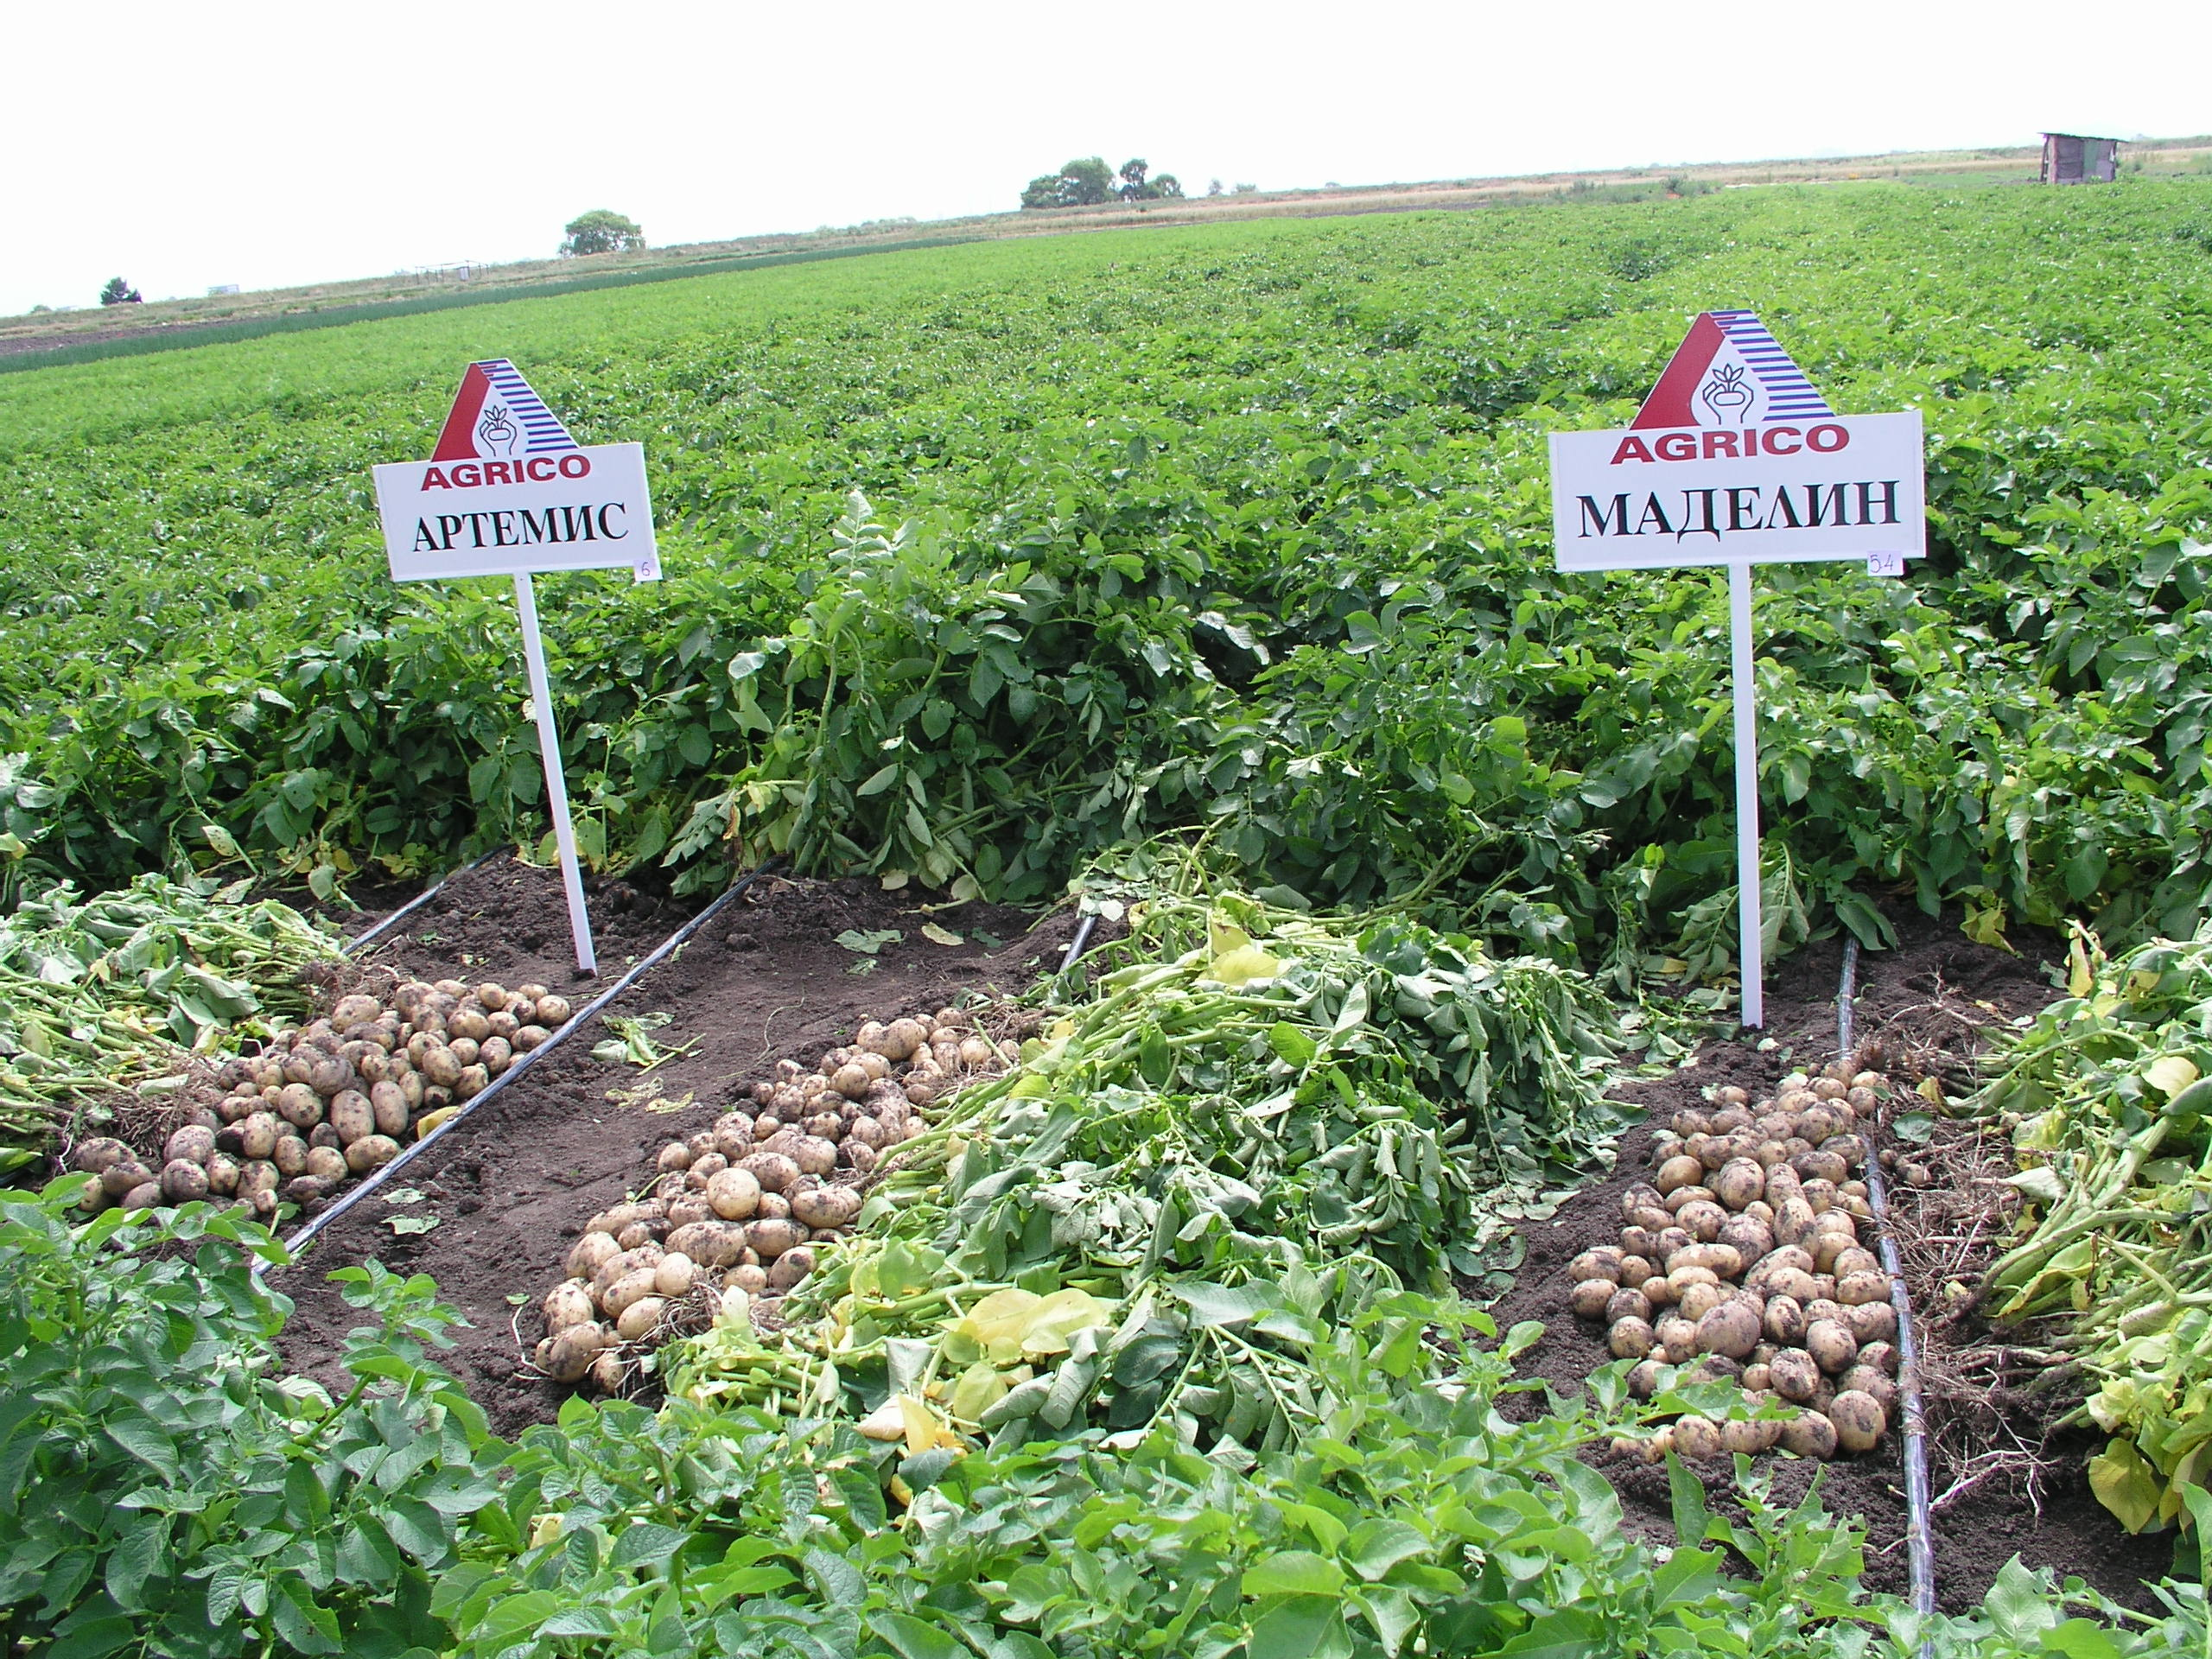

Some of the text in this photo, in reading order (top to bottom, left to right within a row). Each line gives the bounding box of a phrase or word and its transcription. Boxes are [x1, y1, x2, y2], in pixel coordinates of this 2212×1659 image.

[1610, 424, 1850, 465] AGRICO
[421, 454, 591, 491] AGRICO
[412, 502, 629, 552] АРТЕМИС
[1576, 480, 1901, 543] МАДЕЛИН
[641, 561, 651, 576] 6
